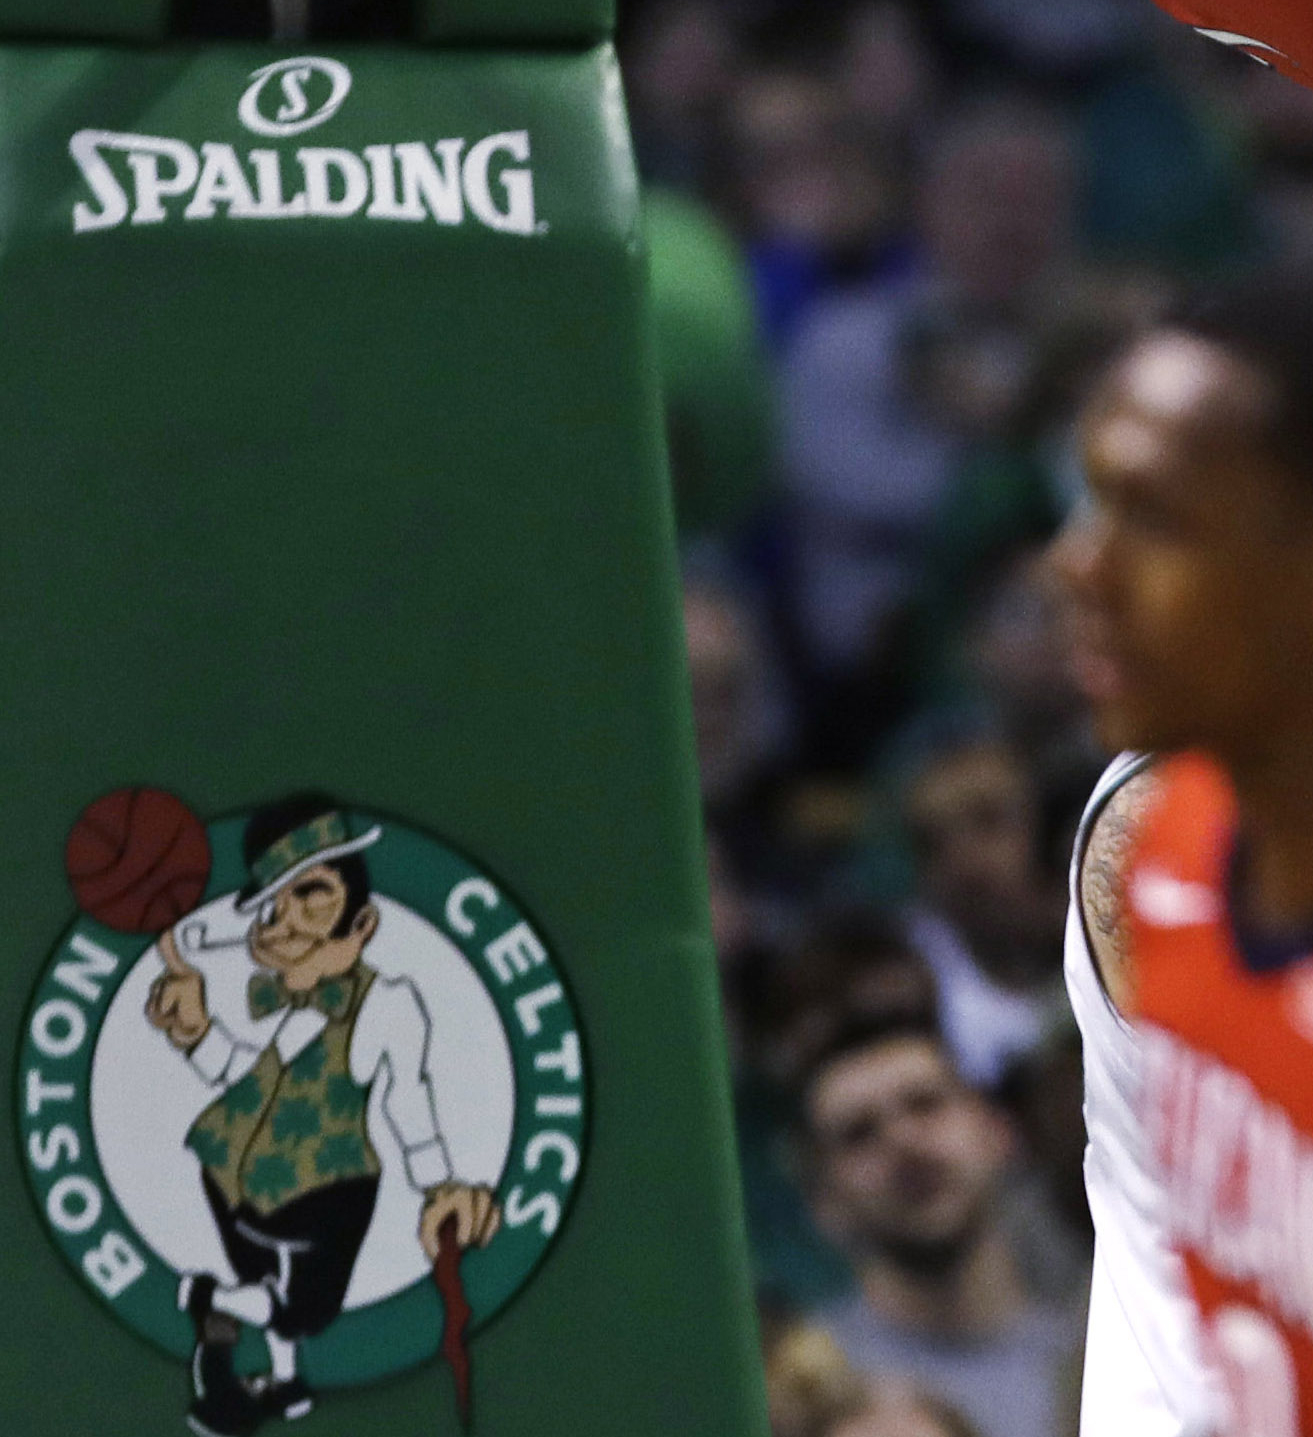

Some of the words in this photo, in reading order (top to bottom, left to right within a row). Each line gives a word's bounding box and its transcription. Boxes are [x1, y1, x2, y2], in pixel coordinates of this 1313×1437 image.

[68, 128, 537, 237] SPALDING
[25, 933, 148, 1300] BOSTON
[444, 876, 582, 1236] CELTICS
